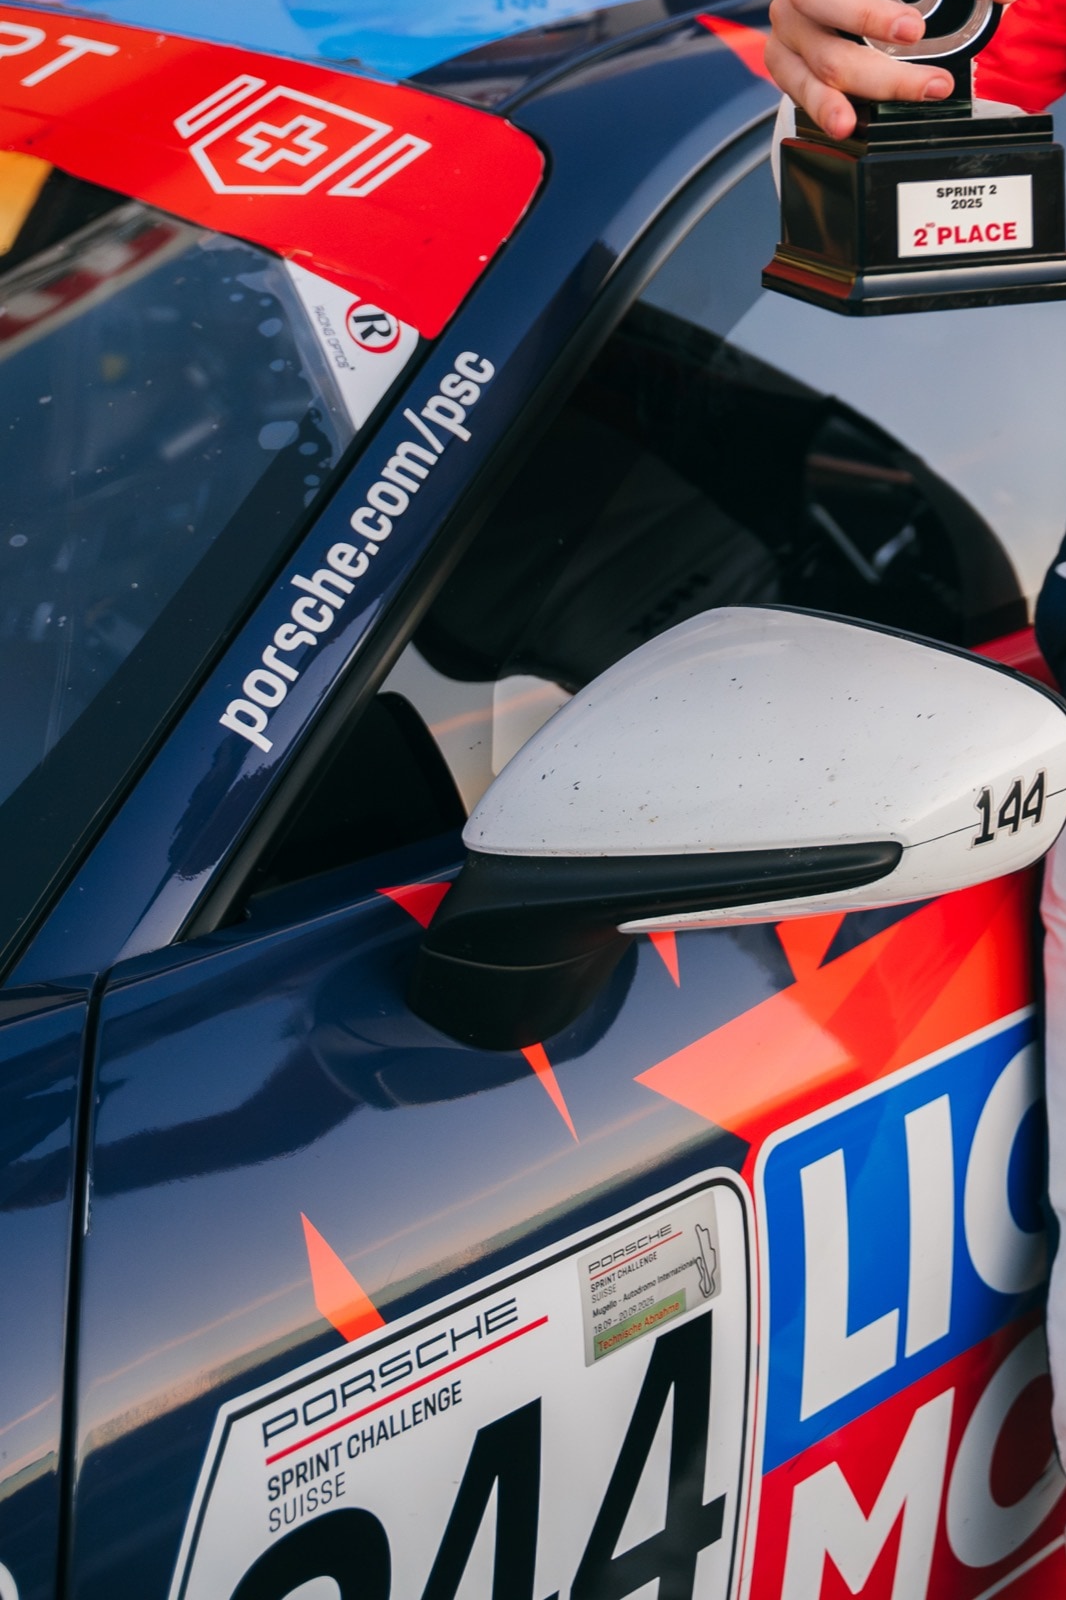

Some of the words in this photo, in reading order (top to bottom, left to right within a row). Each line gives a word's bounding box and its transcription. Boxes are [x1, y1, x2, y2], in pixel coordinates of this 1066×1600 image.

[936, 185, 986, 198] SPRINT
[988, 184, 998, 195] 2
[951, 198, 983, 210] 2025
[937, 222, 1017, 245] PLACE
[327, 338, 351, 369] OPTICS
[218, 350, 496, 754] porsche.com/psc
[974, 771, 1045, 846] 144
[588, 1224, 673, 1274] PORSCHE
[590, 1273, 616, 1293] SPRINT
[617, 1251, 658, 1279] CHALLENGE
[592, 1285, 617, 1304] SUISSE
[592, 1299, 618, 1318] Mugello
[623, 1280, 657, 1304] Autodromo
[597, 1322, 643, 1351] Technische
[644, 1301, 680, 1327] Abnahme
[262, 1297, 517, 1448] PORSCHE
[267, 1440, 344, 1502] SPRINT
[347, 1379, 463, 1461] CHALLENGE
[268, 1472, 347, 1534] SUISSE
